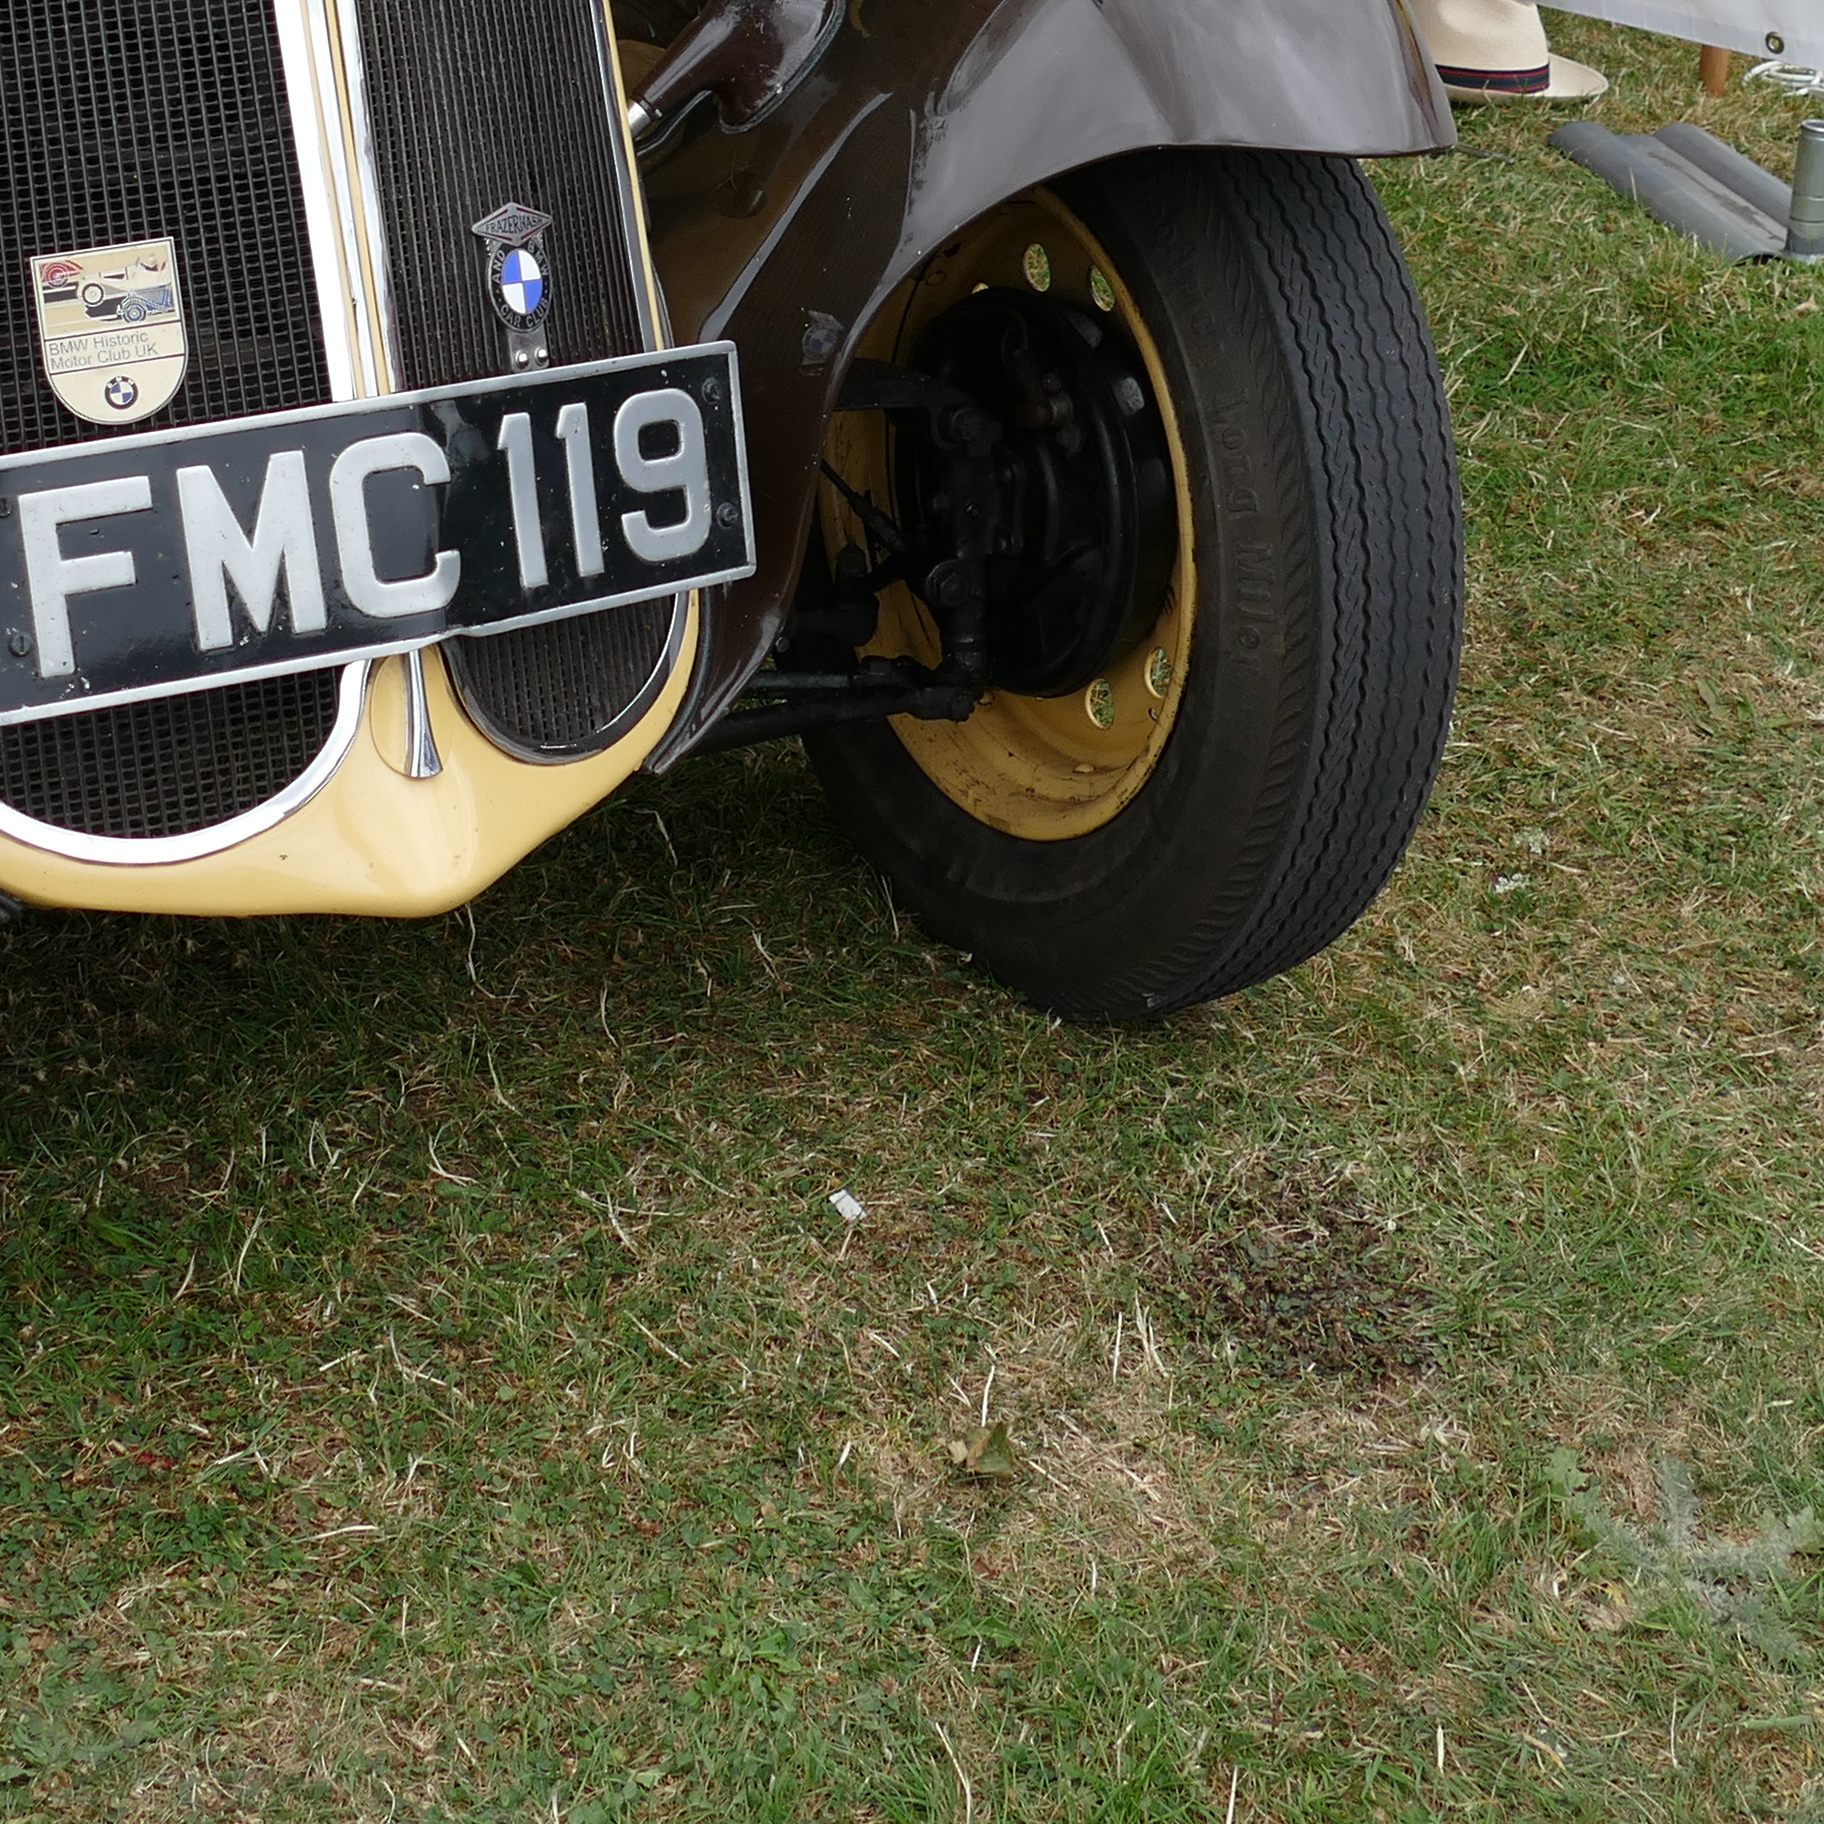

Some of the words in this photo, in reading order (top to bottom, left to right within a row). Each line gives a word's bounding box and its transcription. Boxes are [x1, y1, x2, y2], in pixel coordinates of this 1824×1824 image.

[491, 249, 506, 284] AND
[527, 240, 549, 276] BMW
[500, 303, 521, 328] CAR
[526, 298, 549, 328] CLUB
[49, 338, 89, 356] BMW
[93, 331, 149, 349] Historic
[50, 354, 93, 371] Motor
[97, 348, 131, 364] Club
[135, 342, 159, 358] UK
[17, 432, 461, 679] FMC
[497, 387, 712, 589] 119
